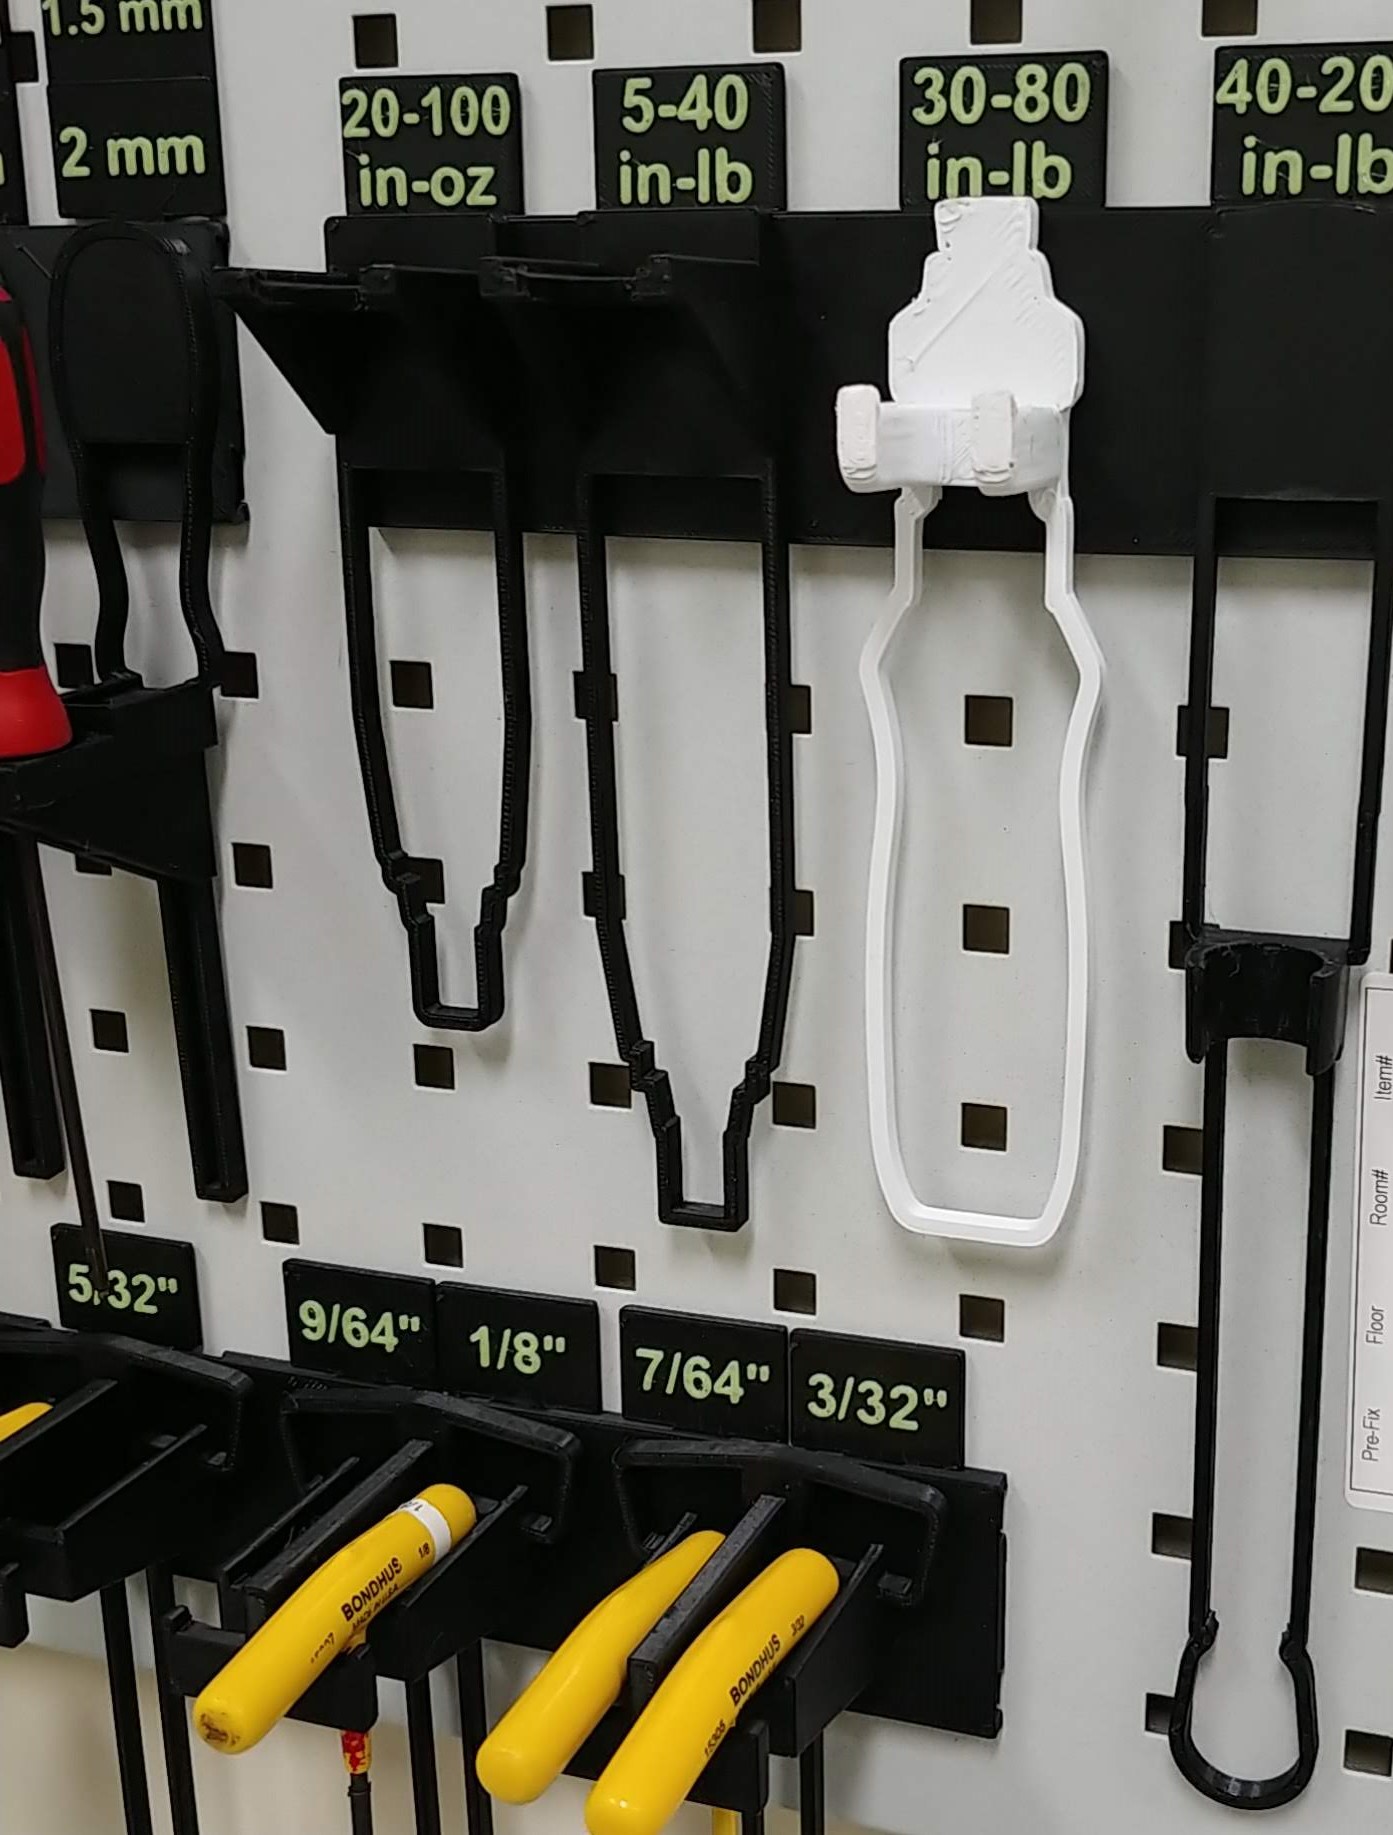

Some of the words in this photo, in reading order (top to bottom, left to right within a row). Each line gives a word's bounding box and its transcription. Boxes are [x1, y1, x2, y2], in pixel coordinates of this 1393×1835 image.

[42, 0, 106, 36] 1.5
[118, 0, 203, 33] mm
[341, 86, 511, 139] 20-100
[621, 74, 749, 134] 5-40
[911, 62, 1091, 125] 30-80
[58, 126, 91, 178] 2
[106, 134, 206, 176] mm
[359, 153, 498, 207] in-oz
[619, 146, 753, 205] in-lb
[926, 140, 1072, 199] in-lb
[1242, 133, 1393, 195] in-lb
[1374, 1054, 1393, 1100] Item#
[1370, 1168, 1390, 1226] Room#
[300, 1300, 420, 1353] 9/64"
[469, 1325, 566, 1375] 1/8"
[1366, 1305, 1385, 1345] Floor
[635, 1347, 770, 1404] 7/64"
[807, 1373, 948, 1431] 3/32"
[1361, 1407, 1381, 1462] Pre-Fix
[340, 1557, 402, 1622] BONDHUS
[728, 1633, 781, 1706] BONDHUS
